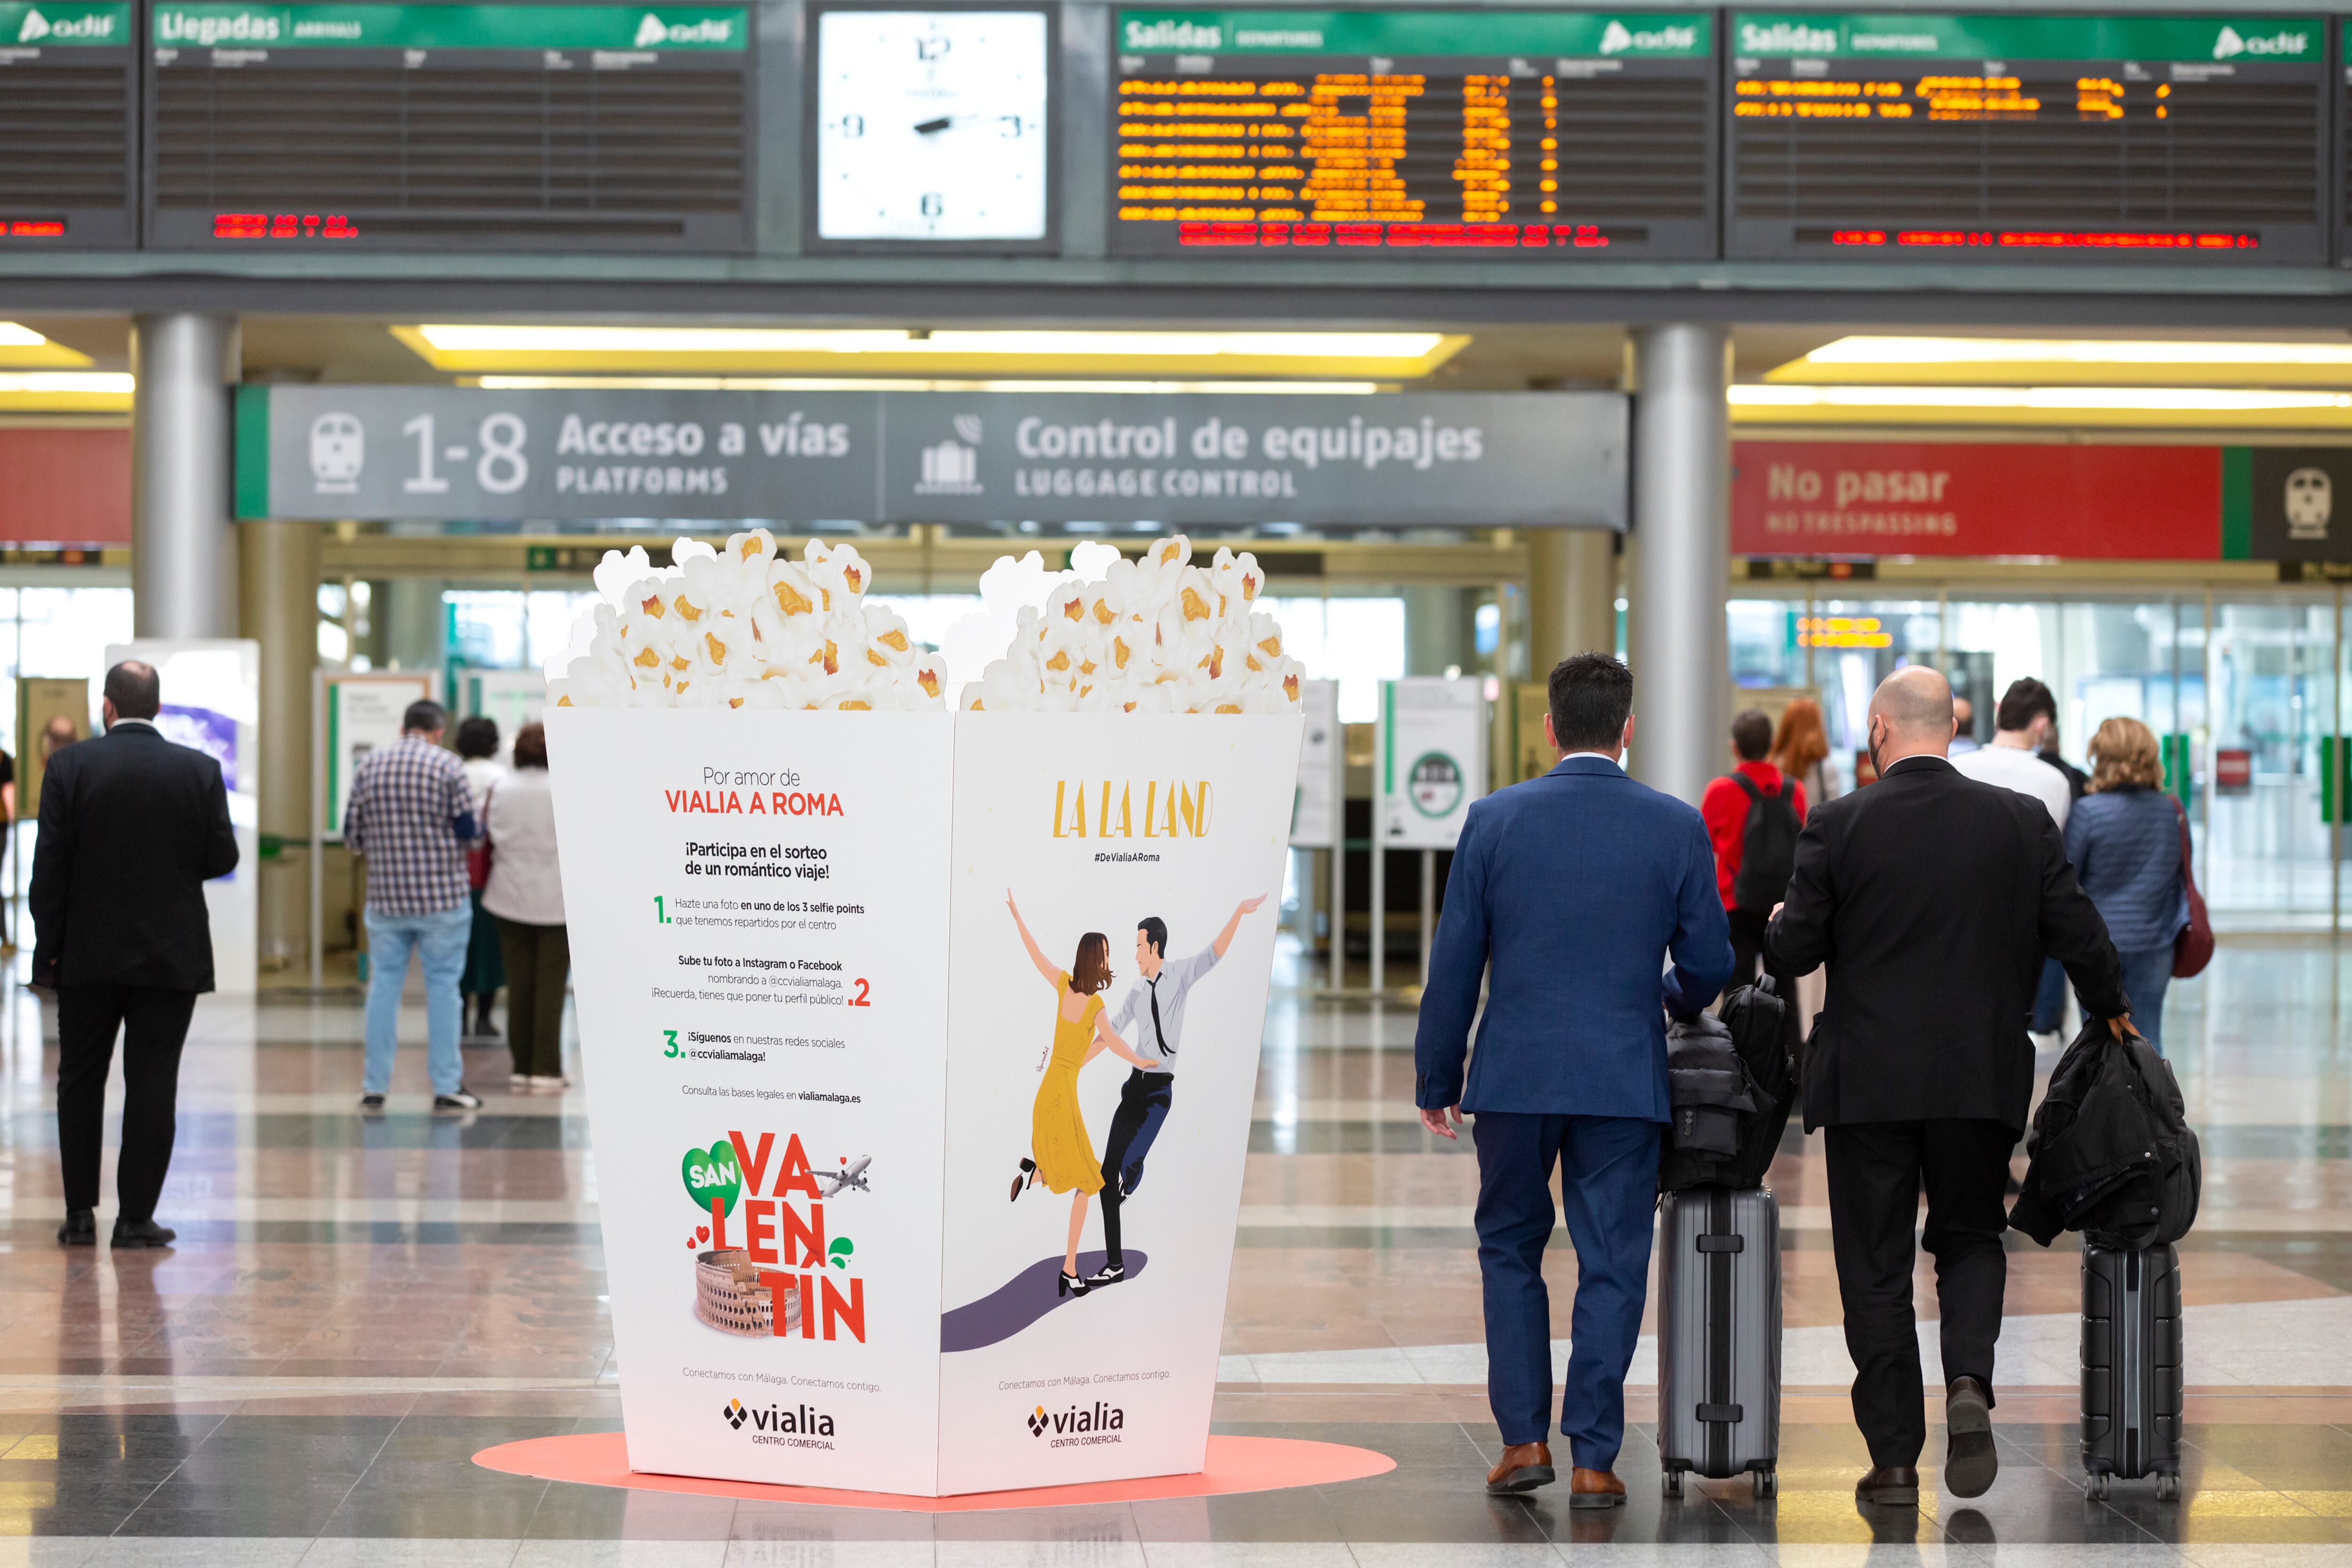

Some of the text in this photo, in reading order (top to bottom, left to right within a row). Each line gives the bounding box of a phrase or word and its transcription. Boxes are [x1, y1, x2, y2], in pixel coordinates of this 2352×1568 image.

[162, 13, 279, 45] Llegadas
[1126, 21, 1222, 49] Salidas
[1740, 24, 1836, 52] Salidas
[843, 116, 863, 138] 9
[1001, 117, 1021, 138] 3
[922, 193, 942, 217] 6
[403, 412, 850, 493] 1-8 Acceso a vías
[1016, 416, 1483, 470] Control de equipajes
[556, 467, 728, 495] PLATFORMS
[1016, 469, 1297, 498] LUGGAGE CONTROL
[1767, 463, 1949, 507] No pasar
[704, 767, 800, 786] Por amor de
[665, 790, 844, 816] VIALIA A ROMA
[1053, 779, 1213, 838] LA LA LAND
[686, 842, 827, 860] ¡Participa en el sorteo
[1095, 852, 1160, 862] #DeVialiaARoma
[685, 860, 829, 881] de un romántico viaje!
[654, 895, 672, 924] 1.
[675, 898, 700, 908] Hazte
[721, 899, 739, 909] foto
[773, 901, 785, 911] de
[787, 901, 800, 912] los
[803, 902, 808, 912] 3
[810, 902, 834, 913] selfie
[836, 903, 864, 915] points
[676, 916, 836, 930] que tenemos repartidos por el centro
[679, 955, 701, 965] Sube
[703, 956, 712, 966] tu
[714, 956, 733, 967] foto
[743, 957, 787, 970] Instagram
[798, 960, 842, 971] Facebook
[708, 973, 759, 985] nombrando
[769, 975, 843, 990] @ccvialiamalaga.
[848, 978, 871, 1007] .2
[652, 987, 843, 1006] ¡Recuerda, tienes que poner tu perfil público!
[663, 1030, 686, 1059] 3.
[688, 1031, 731, 1043] ¡Síguenos
[747, 1035, 783, 1045] nuestras
[786, 1036, 809, 1047] redes
[811, 1038, 845, 1048] sociales
[689, 1048, 765, 1063] @ccvialiamalaga!
[682, 1085, 717, 1096] Consulta
[719, 1087, 730, 1096] las
[731, 1088, 755, 1098] bases
[757, 1089, 784, 1100] legales
[798, 1091, 861, 1104] vialiamalaga.es
[689, 1161, 737, 1189] SAN
[728, 1130, 822, 1200] VA
[683, 1367, 735, 1380] Conectamos
[756, 1373, 788, 1385] Málaga.
[791, 1376, 844, 1389] Conectamos
[847, 1382, 881, 1393] contigo.
[999, 1380, 1045, 1390] Conectamos
[1064, 1376, 1090, 1386] Málaga.
[1094, 1373, 1139, 1383] Conectamos
[1142, 1370, 1170, 1380] contigo.
[752, 1404, 834, 1436] vialia
[1053, 1401, 1123, 1434] vialia
[753, 1435, 835, 1450] CENTRO COMERCIAL
[1051, 1434, 1121, 1448] CENTRO COMERCIAL
